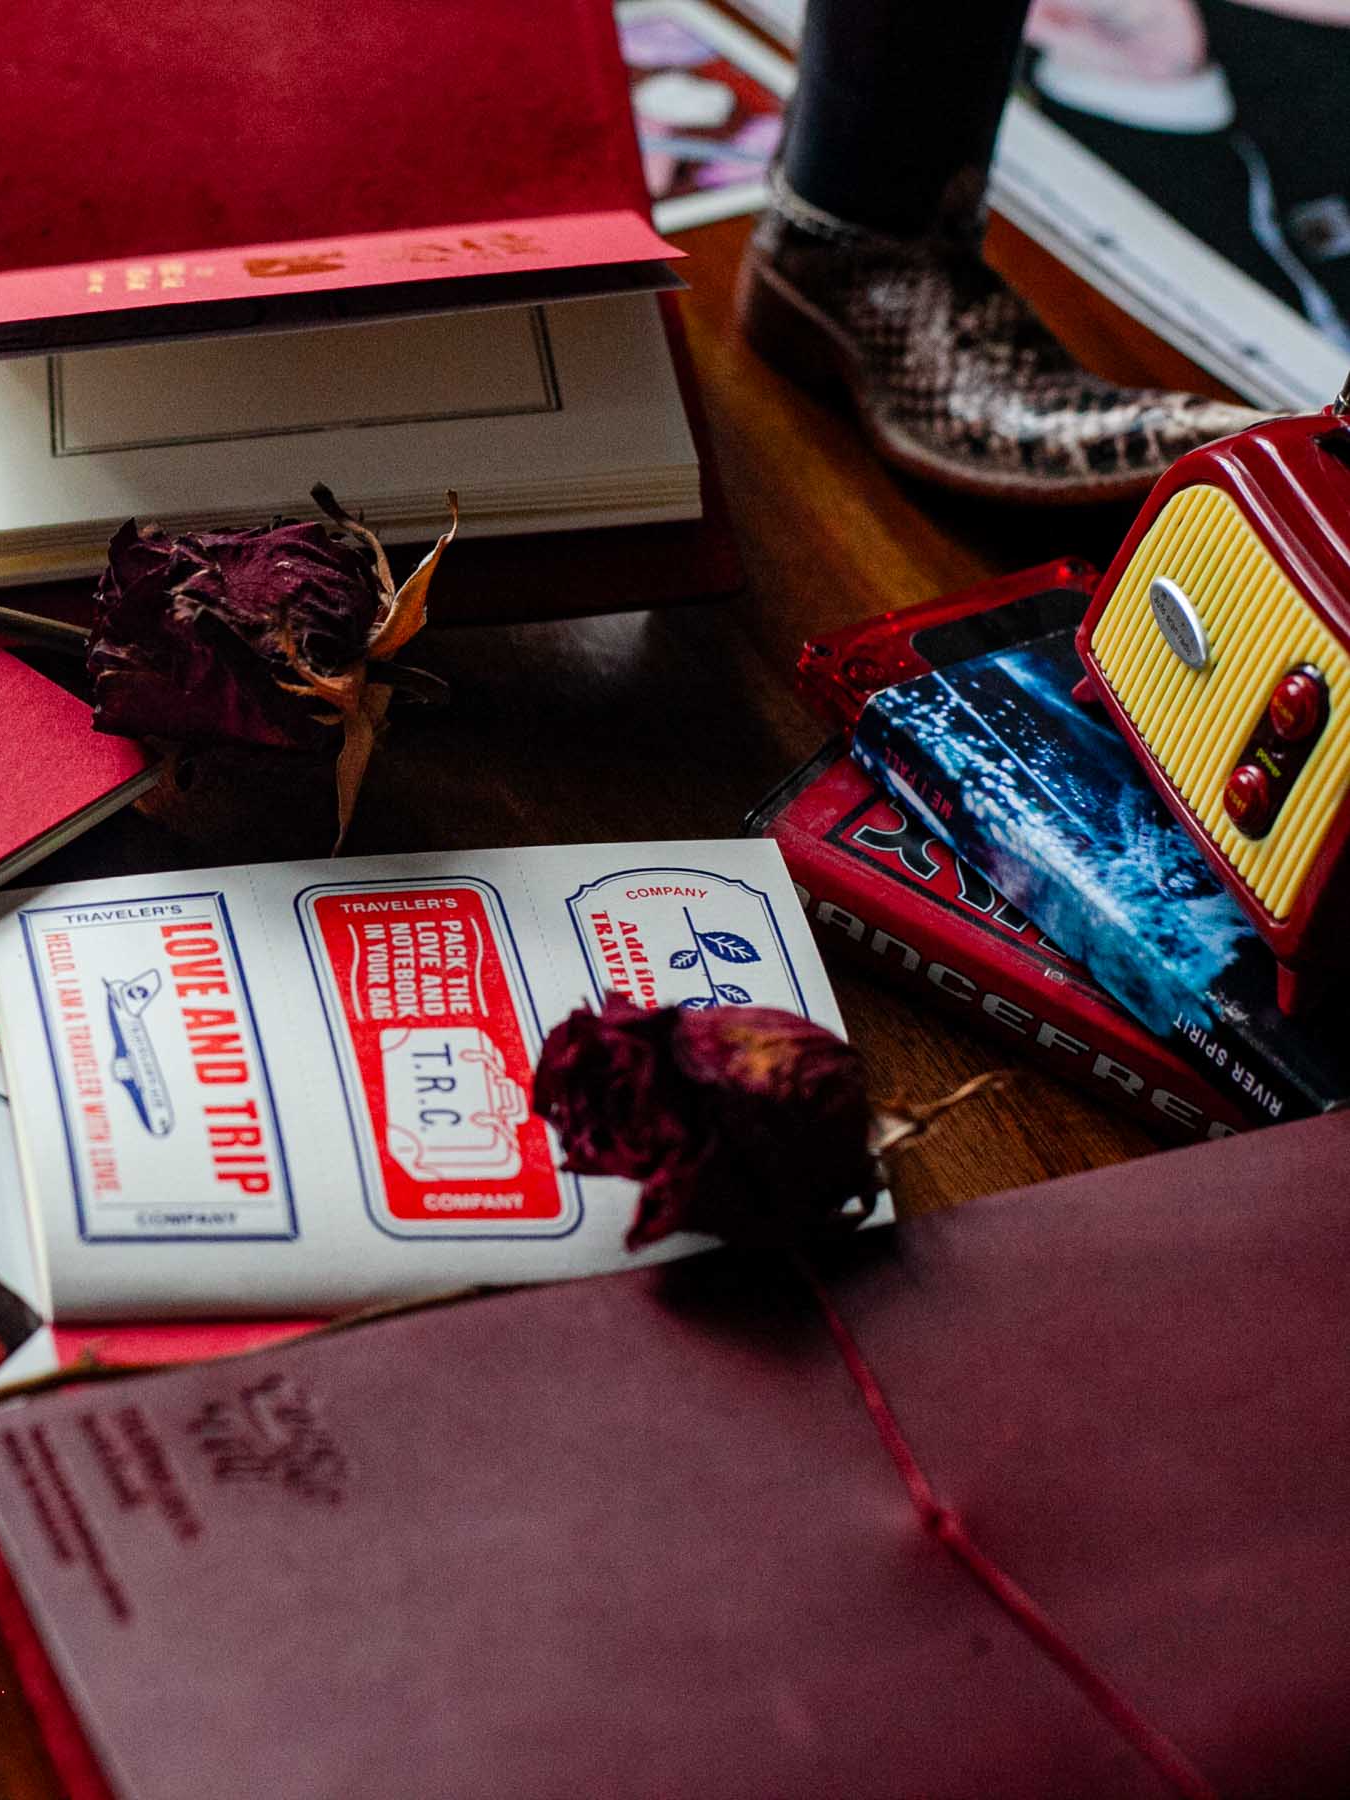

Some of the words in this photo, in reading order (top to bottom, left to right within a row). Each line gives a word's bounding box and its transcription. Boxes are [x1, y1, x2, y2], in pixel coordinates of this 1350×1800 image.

[64, 904, 183, 925] TRAVELER'S
[340, 898, 459, 914] TRAVELER'S
[625, 887, 709, 900] COMPANY
[363, 923, 387, 940] IN
[415, 921, 442, 969] LOVE
[441, 920, 469, 970] PACK
[617, 920, 650, 964] Add
[160, 922, 231, 999] LOVE
[366, 943, 390, 985] YOUR
[389, 922, 421, 1019] NOTEBOOK
[58, 987, 85, 1009] AM
[62, 1012, 87, 1021] A
[368, 991, 394, 1021] BAG
[420, 975, 447, 1017] AND
[446, 976, 473, 1016] THE
[181, 1007, 250, 1085] AND
[1173, 1011, 1228, 1065] SPIRIT
[66, 1024, 106, 1098] TRAVELER
[412, 1043, 462, 1134] T.R.C.
[1230, 1059, 1283, 1118] RIVER
[203, 1099, 273, 1198] TRIP
[422, 1192, 526, 1211] COMPANY
